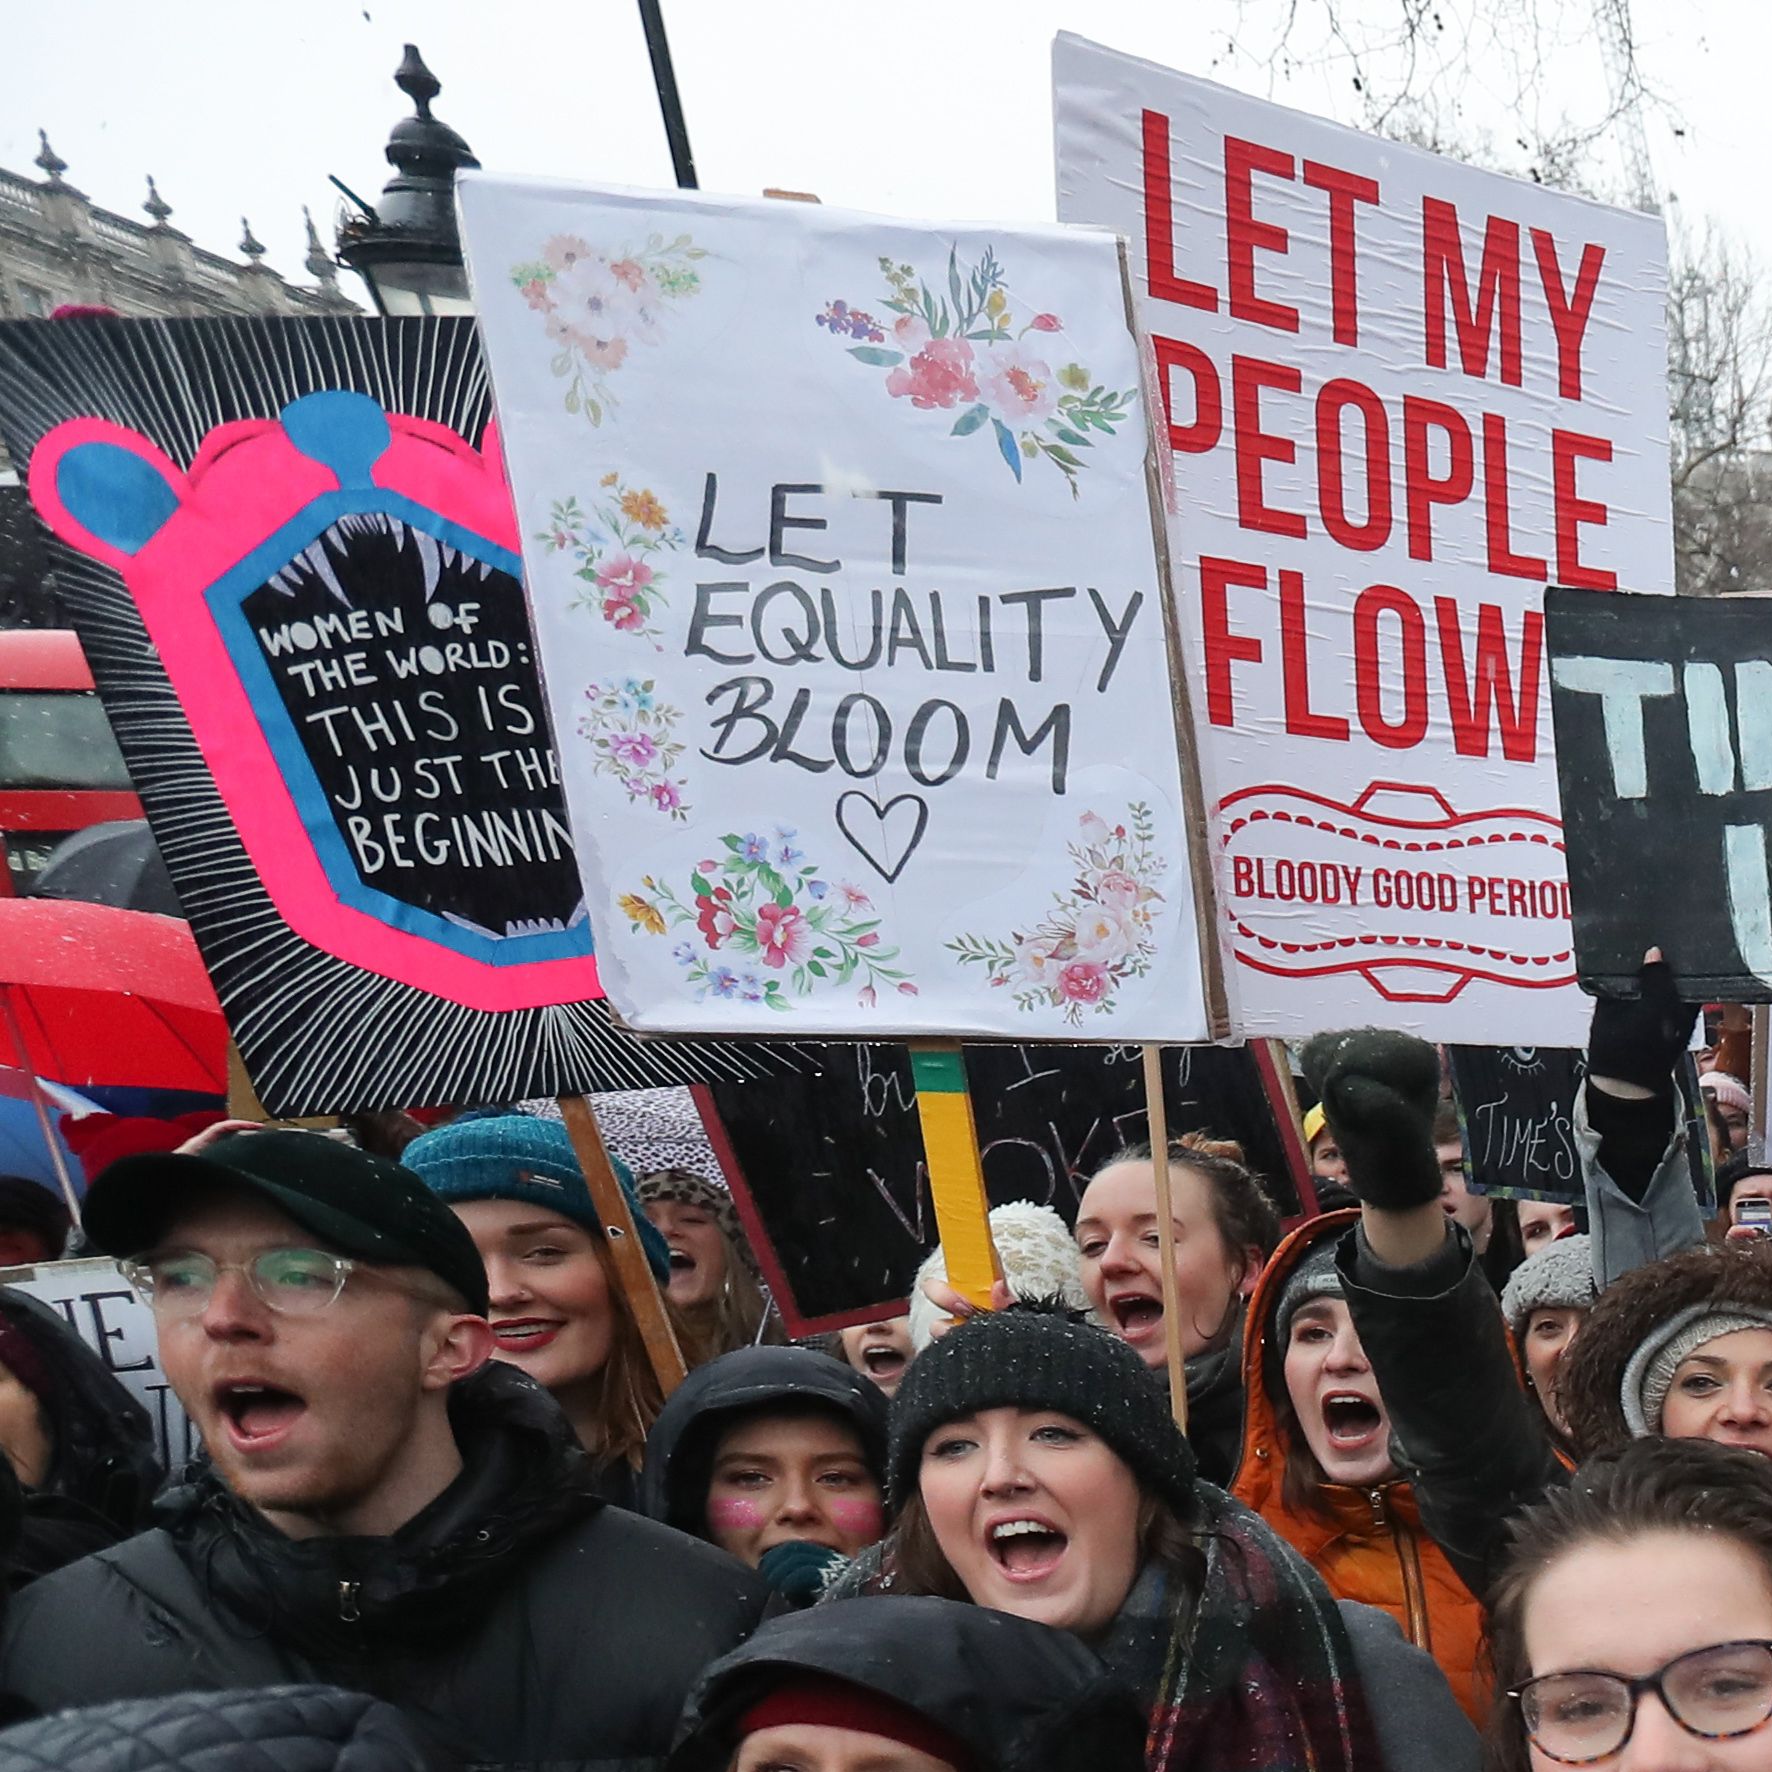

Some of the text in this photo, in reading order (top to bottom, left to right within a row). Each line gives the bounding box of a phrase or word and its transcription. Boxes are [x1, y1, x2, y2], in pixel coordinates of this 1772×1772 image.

[1141, 108, 1606, 401] LET MY
[1151, 334, 1618, 591] PEOPLE
[696, 473, 943, 577] LET
[258, 601, 481, 657] WOMEN OF
[287, 640, 530, 697] THE WORLD:
[685, 579, 1144, 693] EQUALITY
[1198, 553, 1545, 764] FLOW
[305, 683, 535, 757] THIS IS
[703, 675, 1073, 797] BLOOM
[334, 755, 463, 811] JUST
[1233, 855, 1362, 906] BLOODY
[1373, 866, 1458, 913] GOOD
[1476, 1092, 1573, 1181] TIME'S
